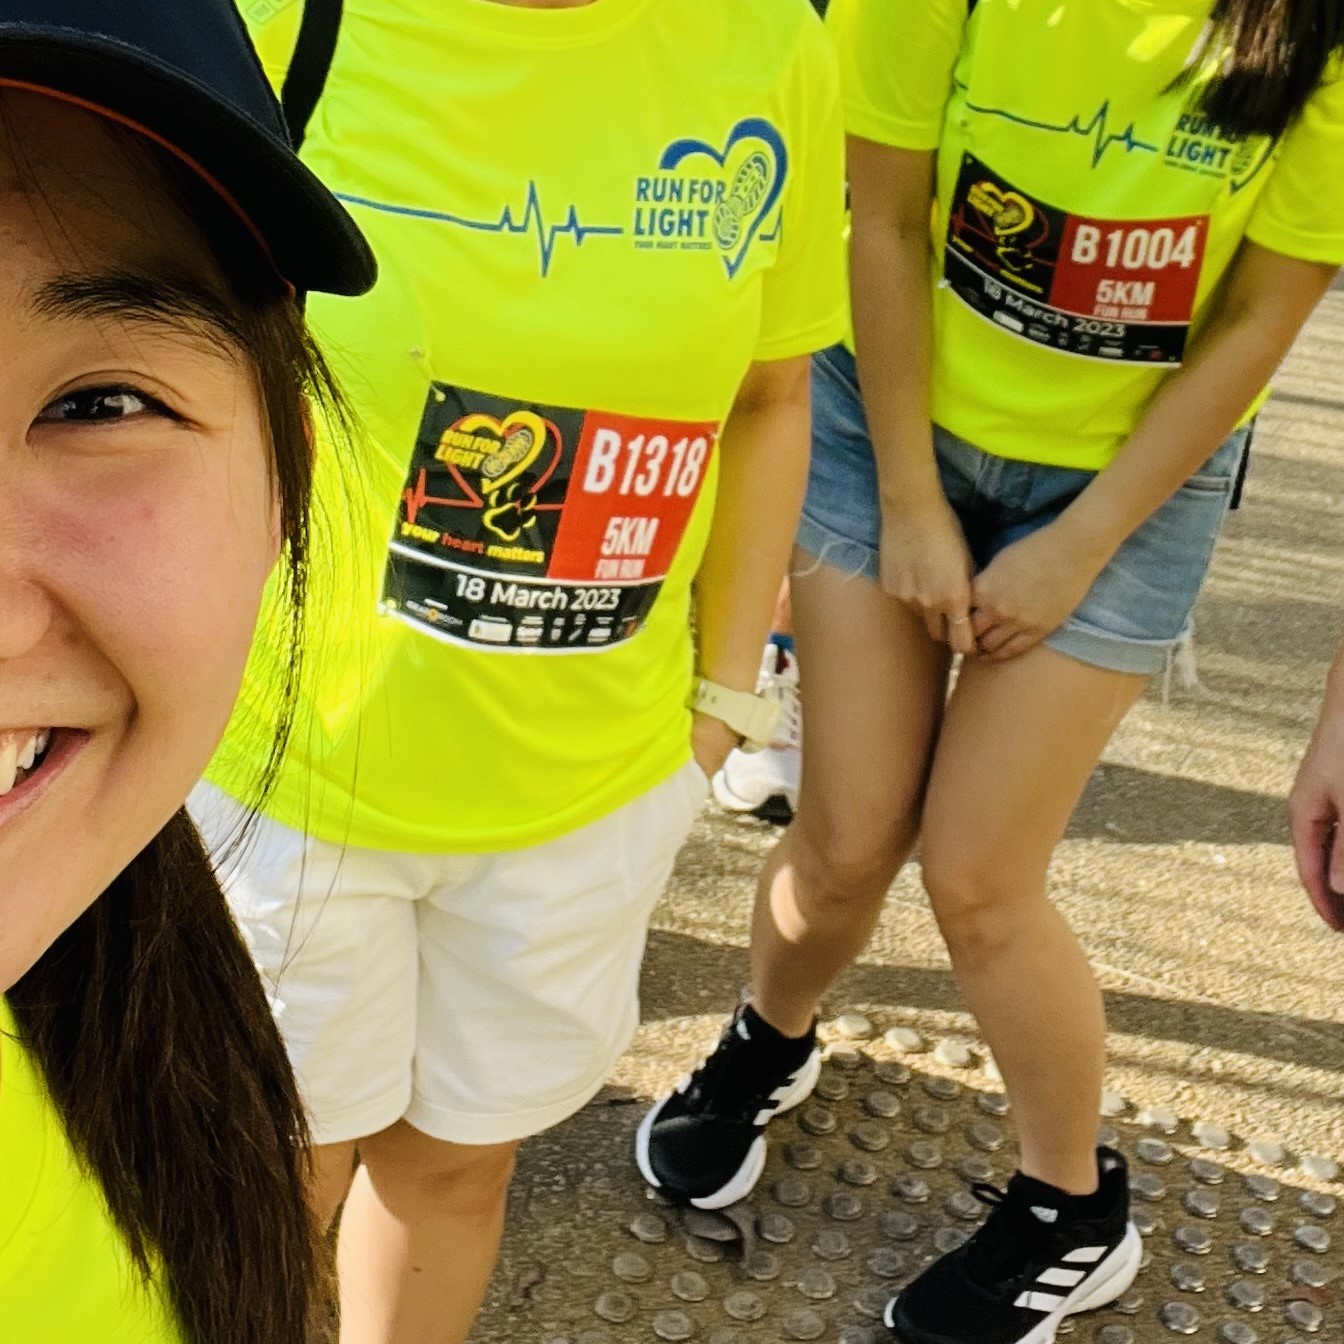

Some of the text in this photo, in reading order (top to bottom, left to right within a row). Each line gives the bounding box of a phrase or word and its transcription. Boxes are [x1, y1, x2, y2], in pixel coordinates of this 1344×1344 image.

[1167, 135, 1231, 169] LIGHT
[636, 177, 727, 205] RUN FOR
[634, 207, 709, 237] LIGHT
[1071, 223, 1197, 270] B1004
[1096, 278, 1156, 306] 5KM
[1005, 292, 1070, 329] March
[1073, 317, 1127, 338] 2023
[434, 443, 485, 470] LIGHT
[582, 427, 708, 497] B1318
[400, 521, 440, 543] your
[441, 532, 485, 554] heart
[600, 516, 659, 556] 5KM
[455, 573, 622, 611] 18 March 2023
